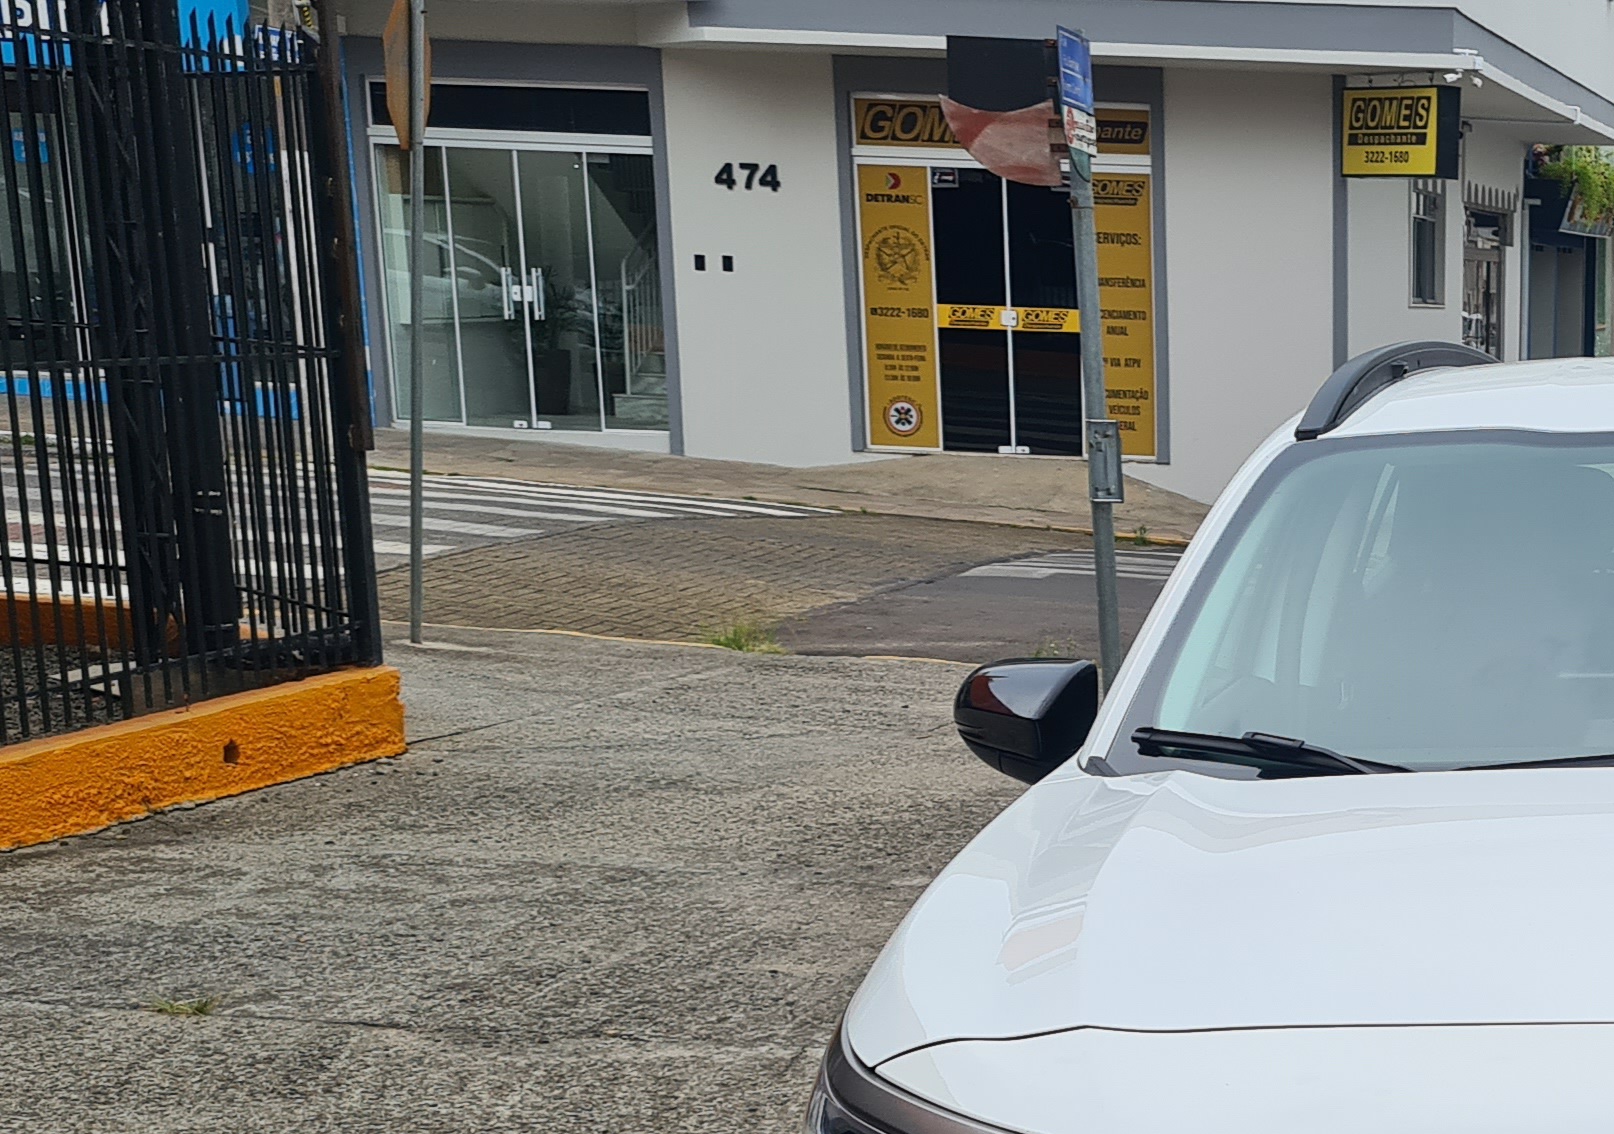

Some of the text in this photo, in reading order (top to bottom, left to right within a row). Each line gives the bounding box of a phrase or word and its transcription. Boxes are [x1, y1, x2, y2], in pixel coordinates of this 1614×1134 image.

[1350, 97, 1430, 129] GOMES
[861, 104, 955, 143] GOM
[1357, 134, 1417, 145] Despachante
[1364, 151, 1409, 163] 3222-1680
[714, 162, 781, 192] 474
[1096, 231, 1142, 246] ERVIÇOS:
[949, 306, 995, 320] GOMES
[1022, 309, 1069, 323] GOMES
[1117, 421, 1138, 431] ERAL
